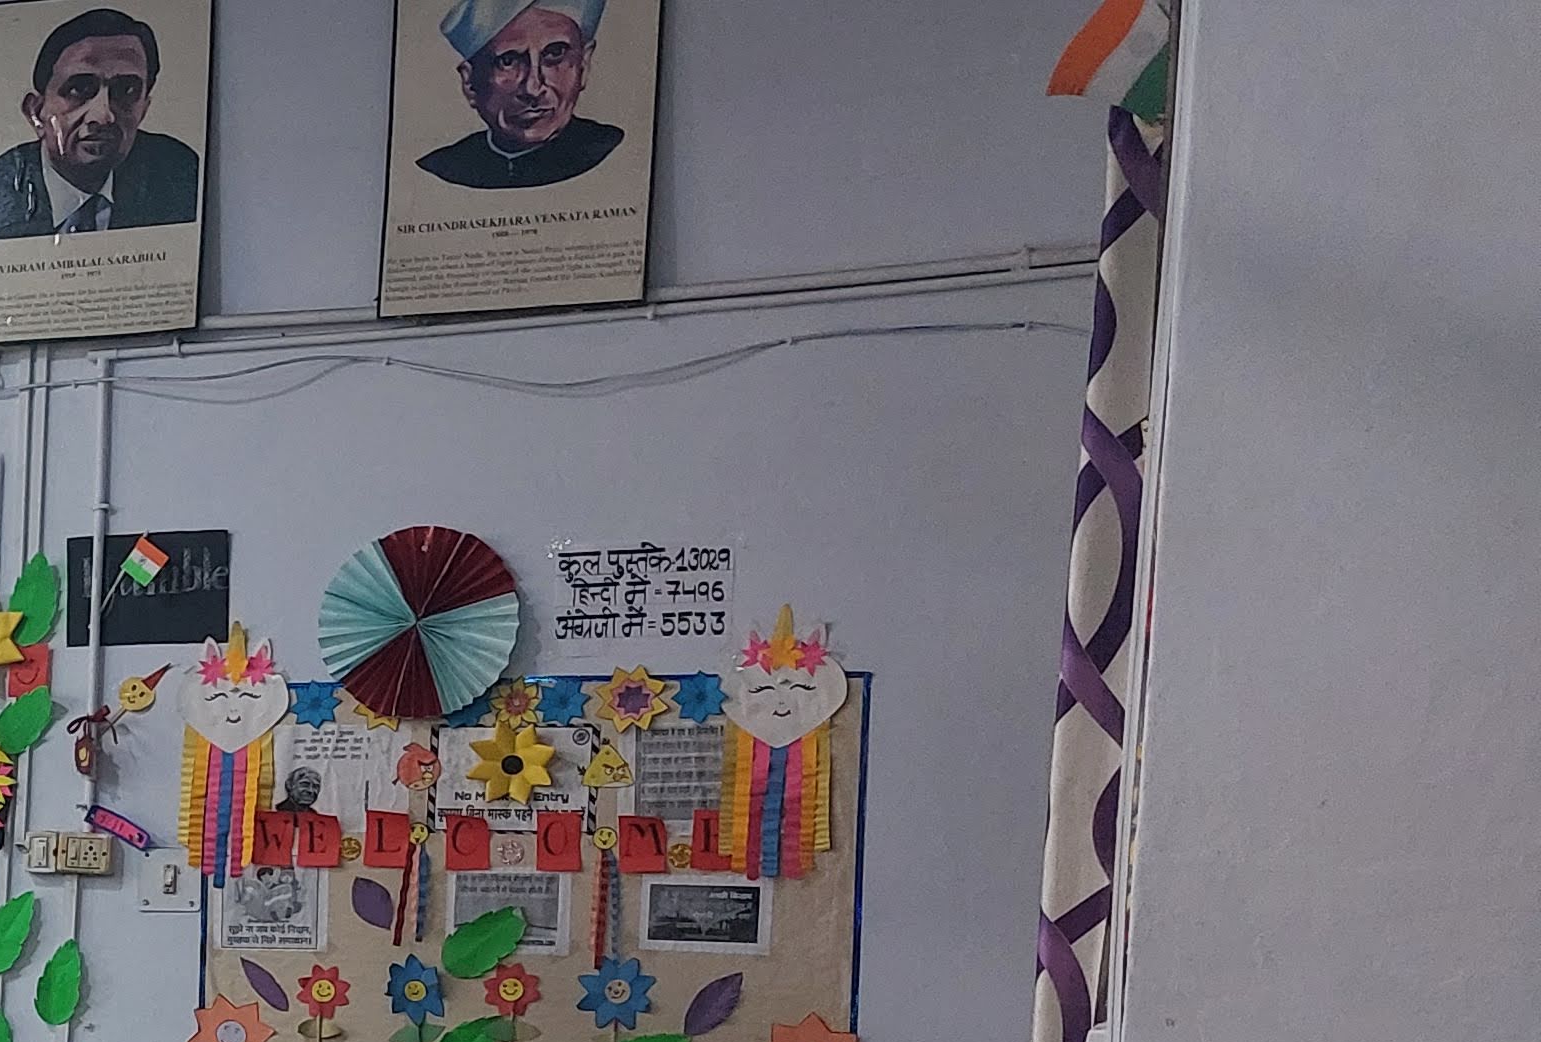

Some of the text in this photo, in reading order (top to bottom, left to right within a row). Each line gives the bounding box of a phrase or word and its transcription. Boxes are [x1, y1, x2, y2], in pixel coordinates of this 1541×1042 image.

[396, 224, 415, 234] SIR
[534, 212, 589, 224] VENKATA
[593, 207, 637, 219] RAMAN
[0, 252, 167, 274] VIKRAM AMBALAL SARABHAI
[558, 551, 602, 583] कुल
[665, 580, 725, 604] 7496
[660, 611, 726, 637] 5533
[454, 791, 472, 801] No
[533, 791, 570, 804] Entry
